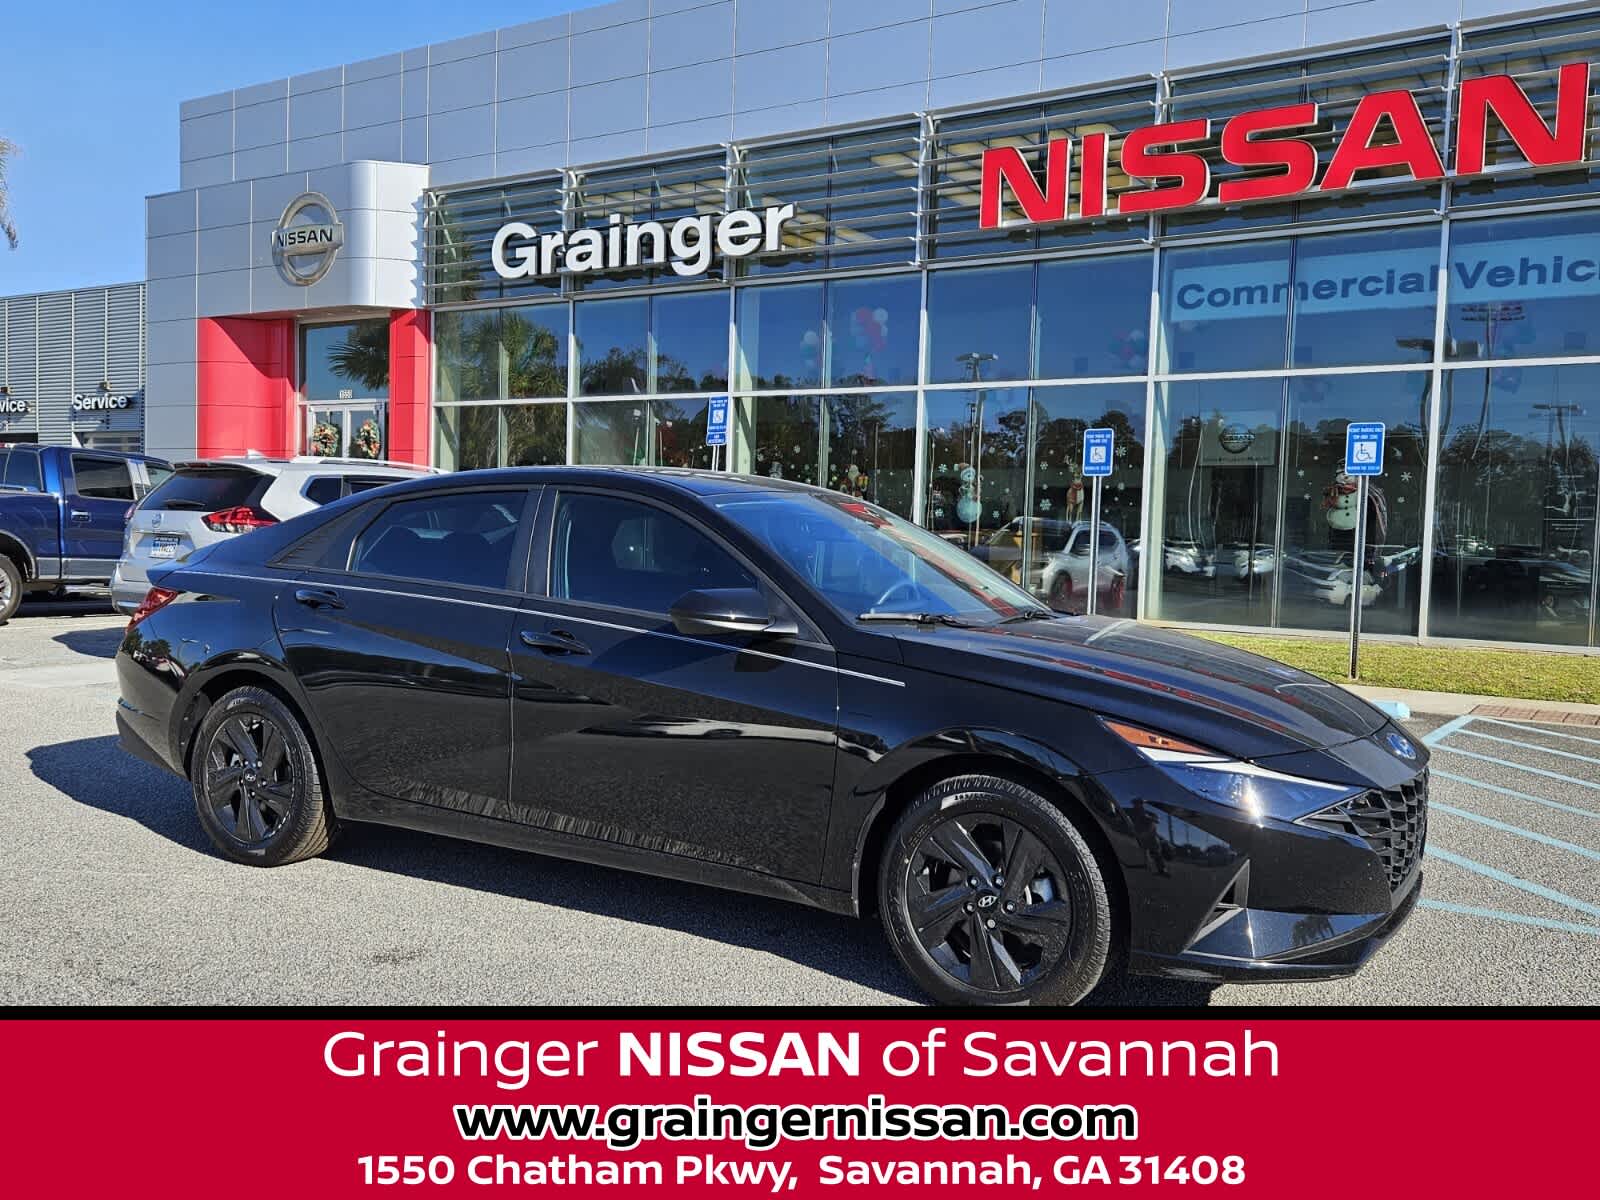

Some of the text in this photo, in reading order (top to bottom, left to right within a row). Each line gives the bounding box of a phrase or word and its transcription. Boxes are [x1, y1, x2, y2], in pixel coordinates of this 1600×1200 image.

[979, 62, 1590, 229] NISSAN
[278, 228, 333, 247] NISSAN
[491, 202, 797, 279] Grainger
[1176, 255, 1600, 310] Commercial Vehic
[73, 393, 128, 410] Service
